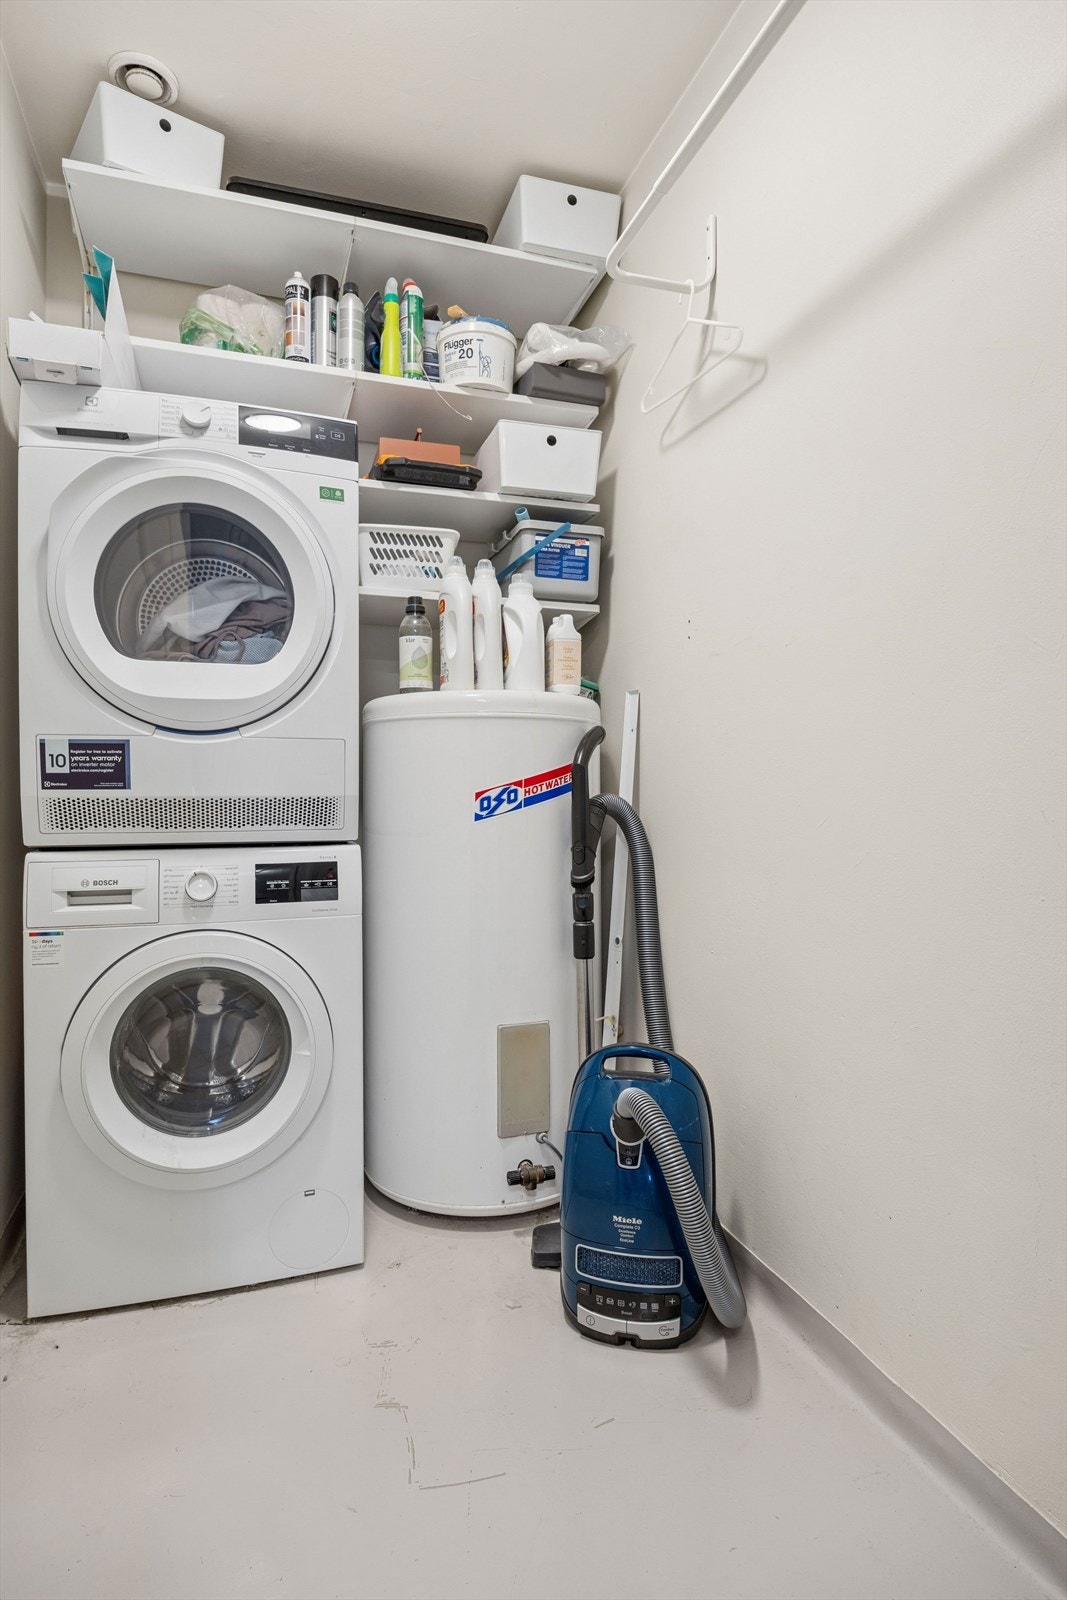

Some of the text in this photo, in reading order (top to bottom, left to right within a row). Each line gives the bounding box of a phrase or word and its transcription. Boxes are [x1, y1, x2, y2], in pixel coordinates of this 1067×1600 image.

[444, 338, 474, 351] Flügger
[458, 347, 474, 360] 20
[48, 753, 67, 768] 10
[612, 1215, 643, 1225] Miele
